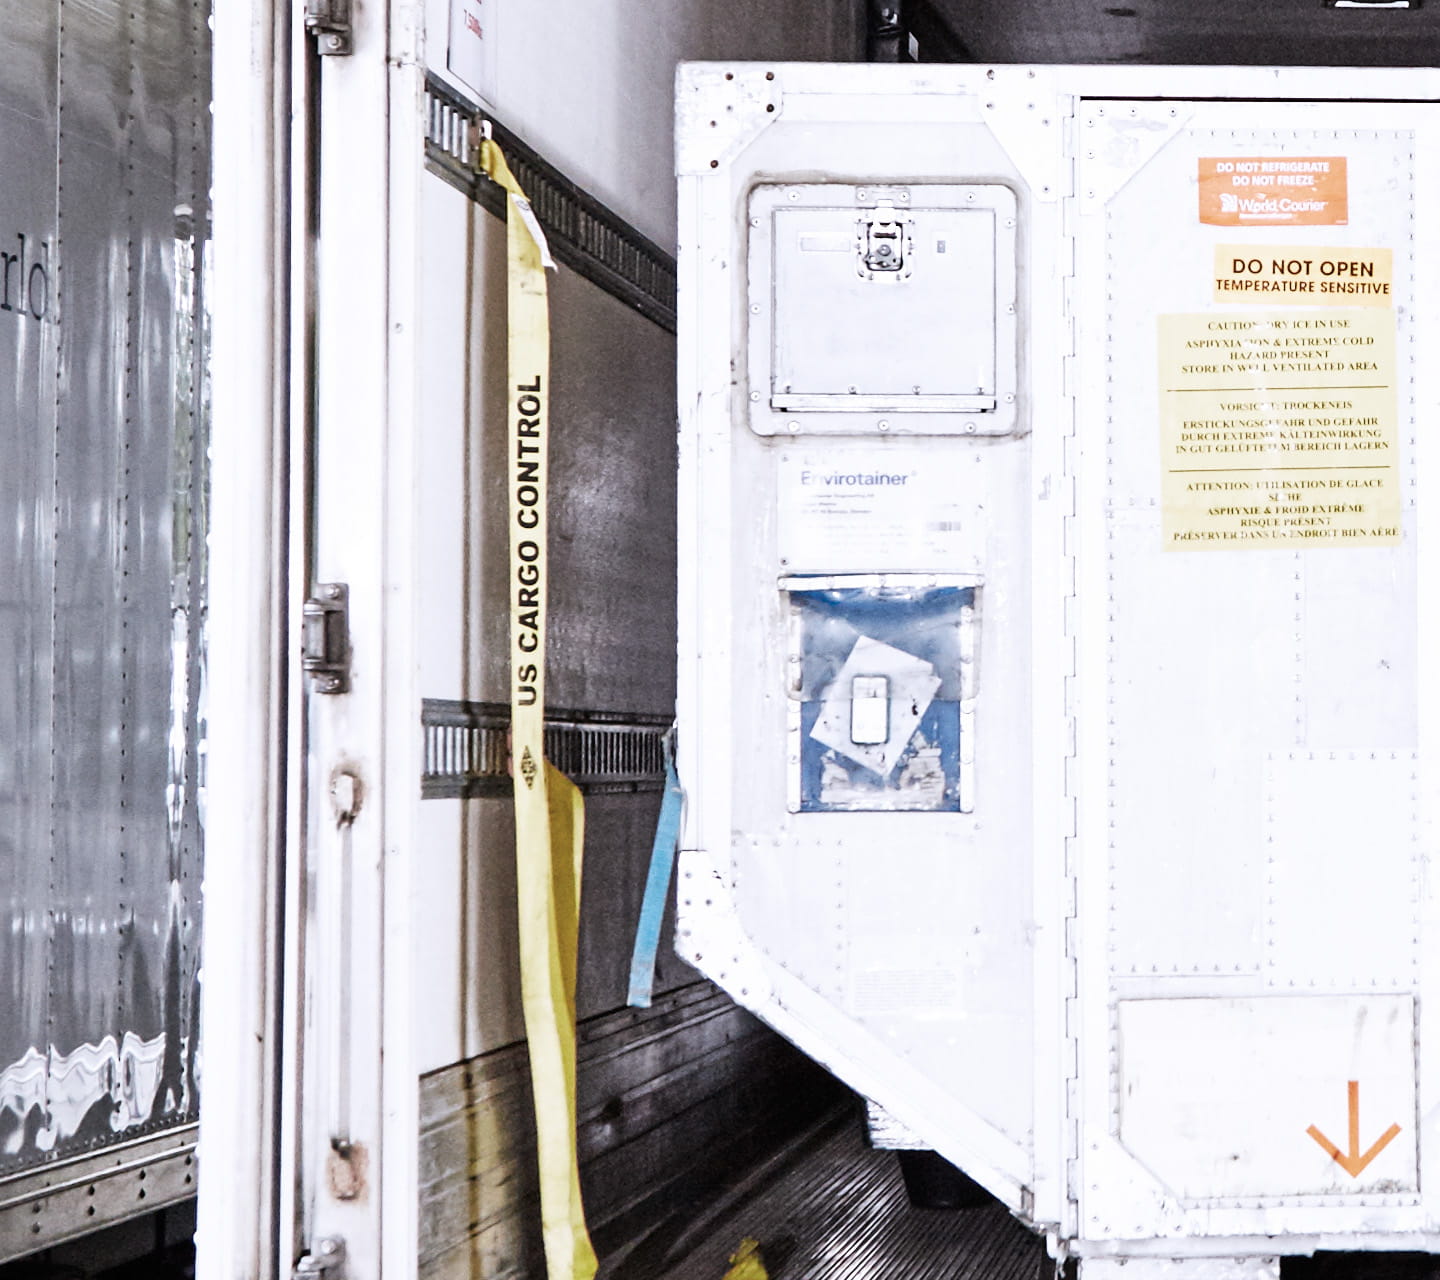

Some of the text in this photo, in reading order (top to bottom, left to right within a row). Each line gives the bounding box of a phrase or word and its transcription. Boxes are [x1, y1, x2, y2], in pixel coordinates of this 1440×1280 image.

[1216, 162, 1330, 173] DO NOT REFRIGERATE
[1232, 175, 1315, 186] DO NOT FREEZE
[1239, 198, 1326, 213] World Courier
[1233, 259, 1374, 277] DO NOT OPEN
[1216, 279, 1390, 295] TEMPERATURE SENSITIVE
[1293, 319, 1312, 330] ICE
[1315, 319, 1327, 329] IN
[1329, 319, 1351, 329] USE
[1273, 338, 1281, 348] &
[1342, 335, 1375, 346] COLD
[1281, 349, 1329, 360] PRESENT
[1181, 363, 1219, 374] STORE
[1222, 364, 1234, 374] IN
[1348, 360, 1378, 372] AREA
[1190, 444, 1212, 454] GUT
[1344, 440, 1389, 451] LAGERN
[1329, 479, 1344, 489] DE
[1346, 478, 1384, 490] GLACE
[1263, 505, 1272, 516] &
[1240, 517, 1280, 529] RISQUE
[1342, 527, 1368, 538] BIEN
[515, 374, 543, 708] US CARGO CONTROL
